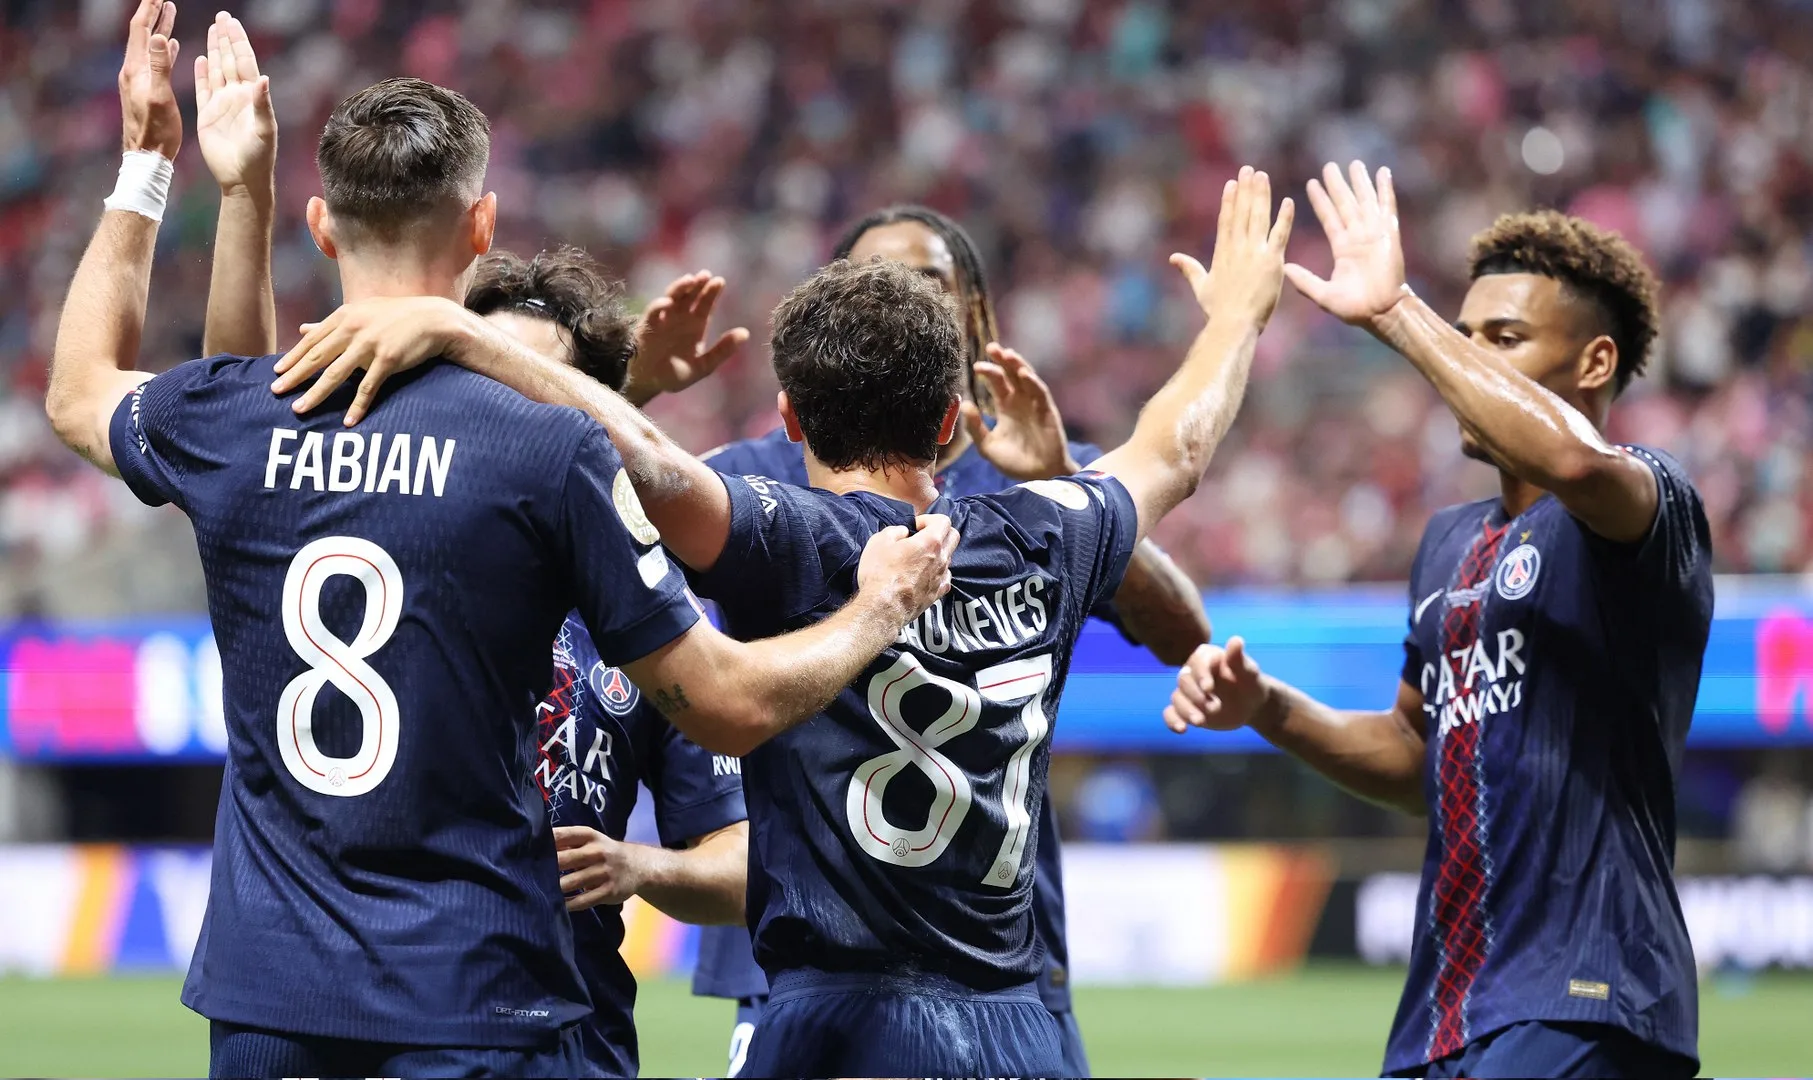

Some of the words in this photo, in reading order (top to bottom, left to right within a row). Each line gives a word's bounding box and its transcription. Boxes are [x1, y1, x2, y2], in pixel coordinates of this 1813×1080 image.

[264, 427, 456, 497] FABIAN
[277, 536, 403, 796] 8
[951, 575, 1047, 653] NEVES
[847, 651, 1052, 888] 87
